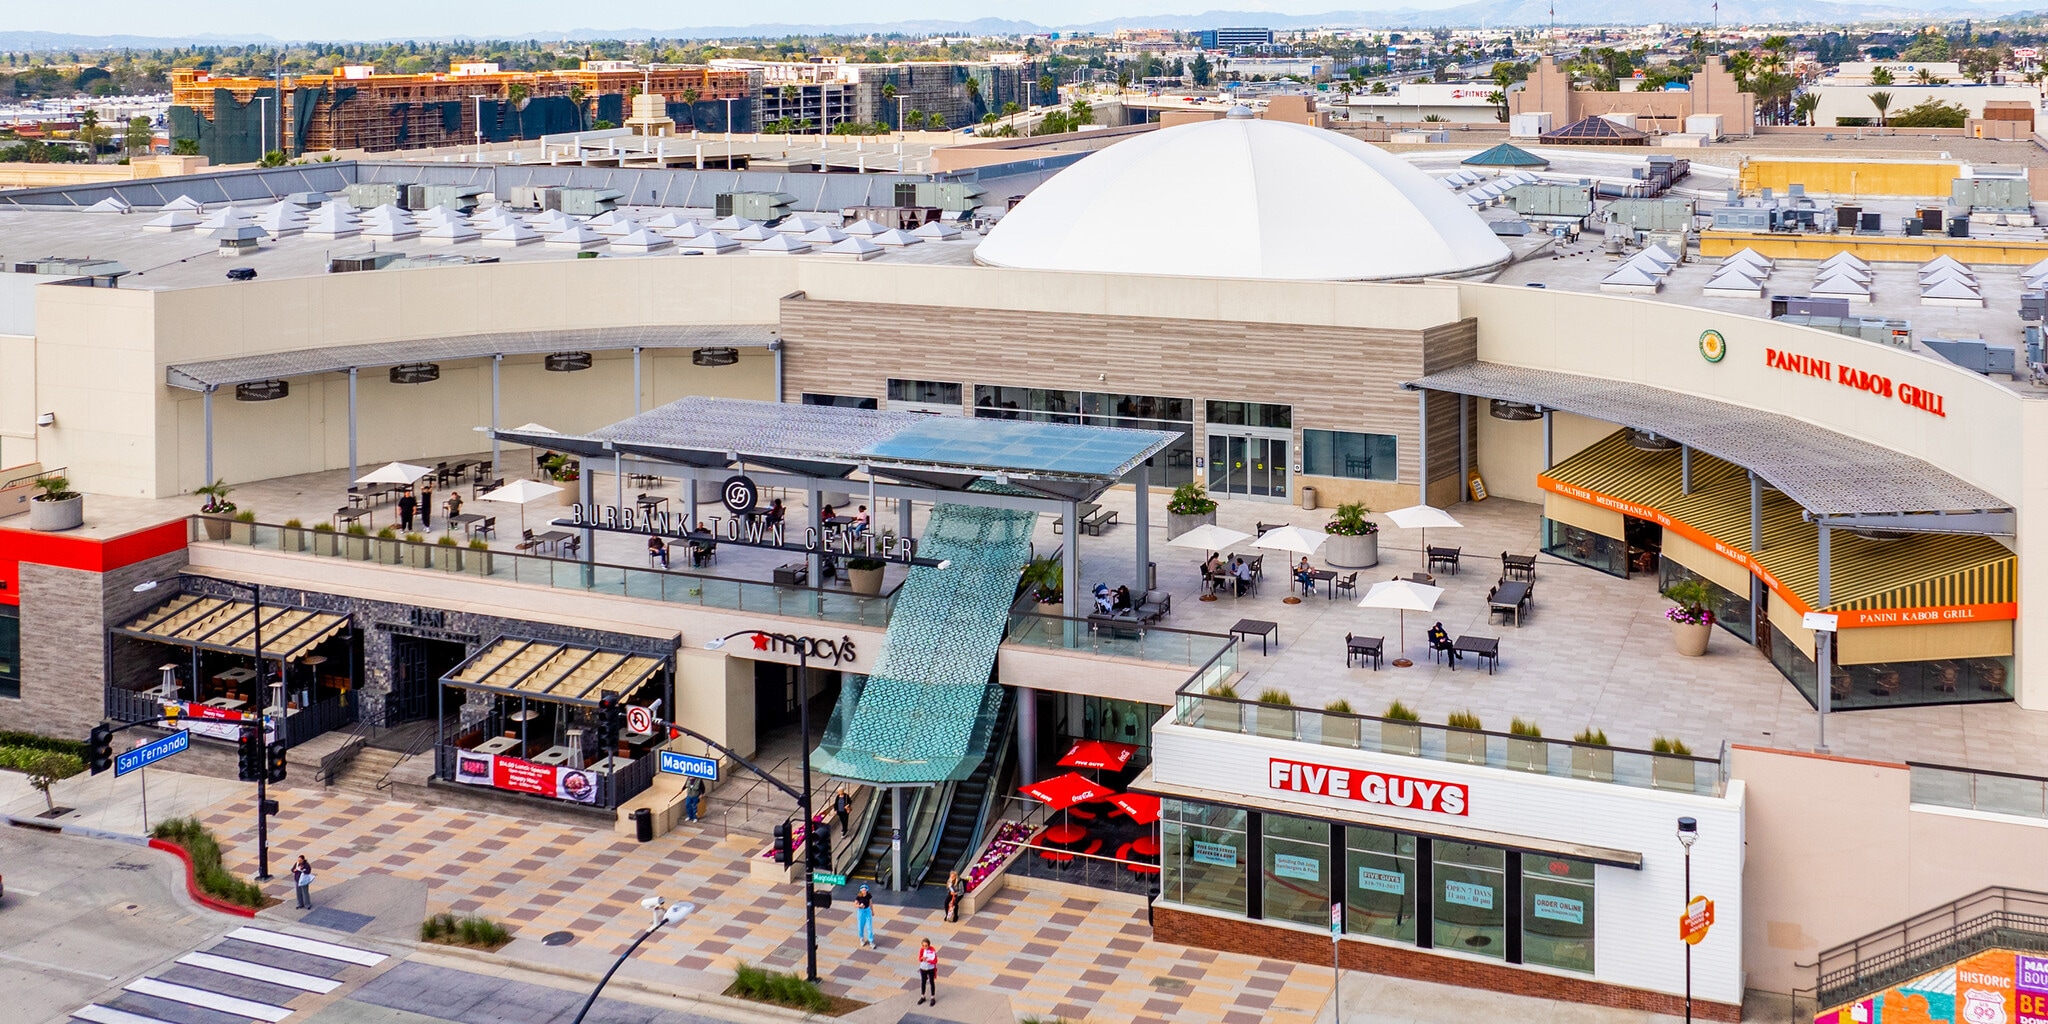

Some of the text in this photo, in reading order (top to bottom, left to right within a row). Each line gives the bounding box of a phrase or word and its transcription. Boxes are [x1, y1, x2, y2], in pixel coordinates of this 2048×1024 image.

[1765, 348, 1946, 418] PANINI KABOB GRILL
[1556, 483, 1590, 500] HEALTHIER
[1596, 496, 1652, 518] MEDITERRANEAN
[1658, 514, 1671, 526] FOOD
[1715, 542, 1747, 563] BREAKFAST
[572, 504, 913, 562] BURBANK TOWN CENTER
[1860, 609, 1974, 623] PANINI KABOB GRILL
[770, 632, 856, 666] macy's
[120, 736, 186, 770] San Fernando
[663, 755, 714, 776] Magnolia
[1270, 761, 1465, 815] FIVE GUYS
[1041, 794, 1052, 802] GUYS
[1125, 805, 1137, 815] GUYS
[814, 873, 837, 883] Magnolia
[1380, 875, 1400, 883] GUYS
[1446, 884, 1466, 893] OPEN
[1474, 889, 1492, 897] DAYS
[1537, 899, 1582, 912] ORDER ONLINE
[1960, 971, 2011, 988] HISTORIC
[1974, 1006, 1995, 1019] 99
[2020, 994, 2048, 1015] BE
